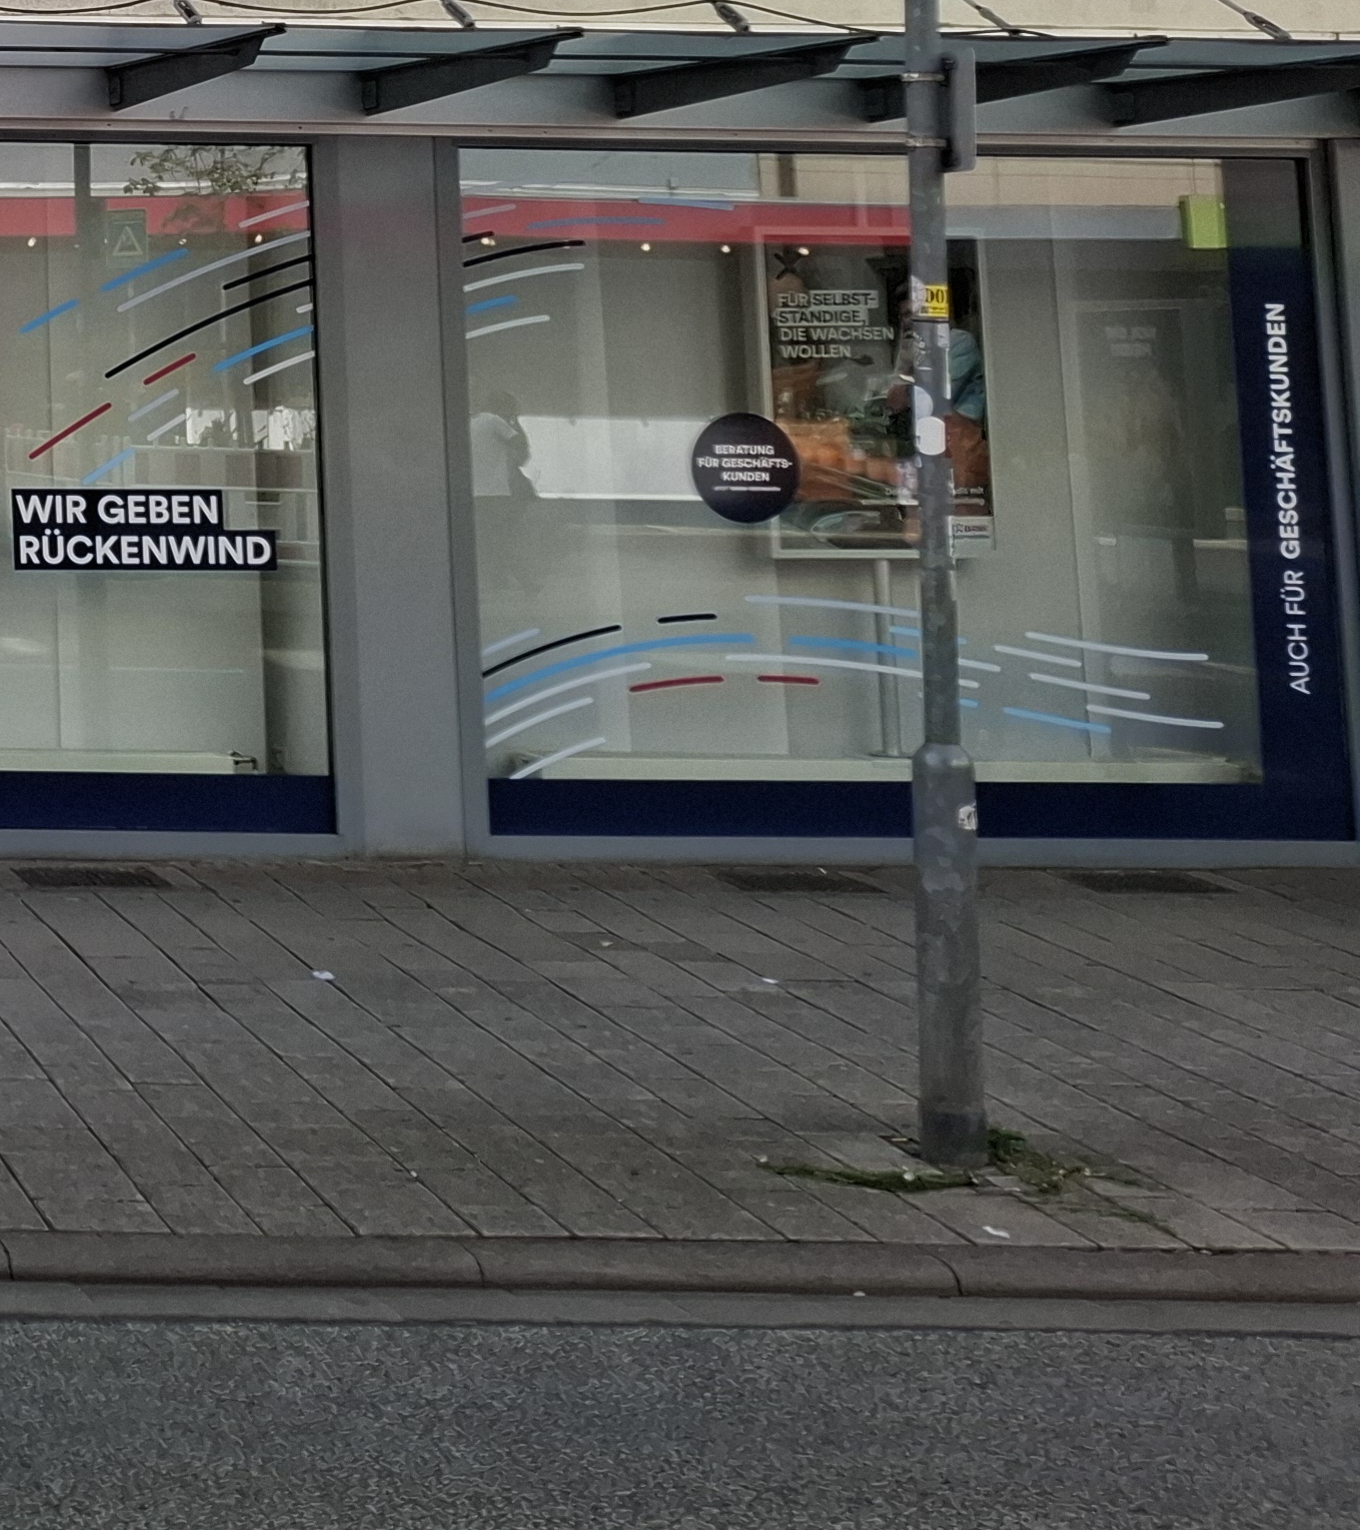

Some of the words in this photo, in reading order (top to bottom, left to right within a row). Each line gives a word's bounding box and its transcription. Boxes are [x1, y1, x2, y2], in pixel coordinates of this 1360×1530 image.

[781, 327, 808, 341] DIE
[810, 326, 895, 341] WACHSEN
[781, 344, 852, 359] WOLLEN
[1264, 302, 1304, 560] GESCHÄFTSKUNDEN
[714, 444, 775, 456] BERATUNG
[697, 456, 720, 469] FÜR
[722, 471, 770, 482] KUNDEN
[15, 494, 88, 524] WIR
[97, 494, 219, 524] GEBEN
[19, 527, 273, 565] RÜCKENWIND
[1280, 569, 1305, 616] FÜR
[1286, 623, 1311, 695] AUCH
